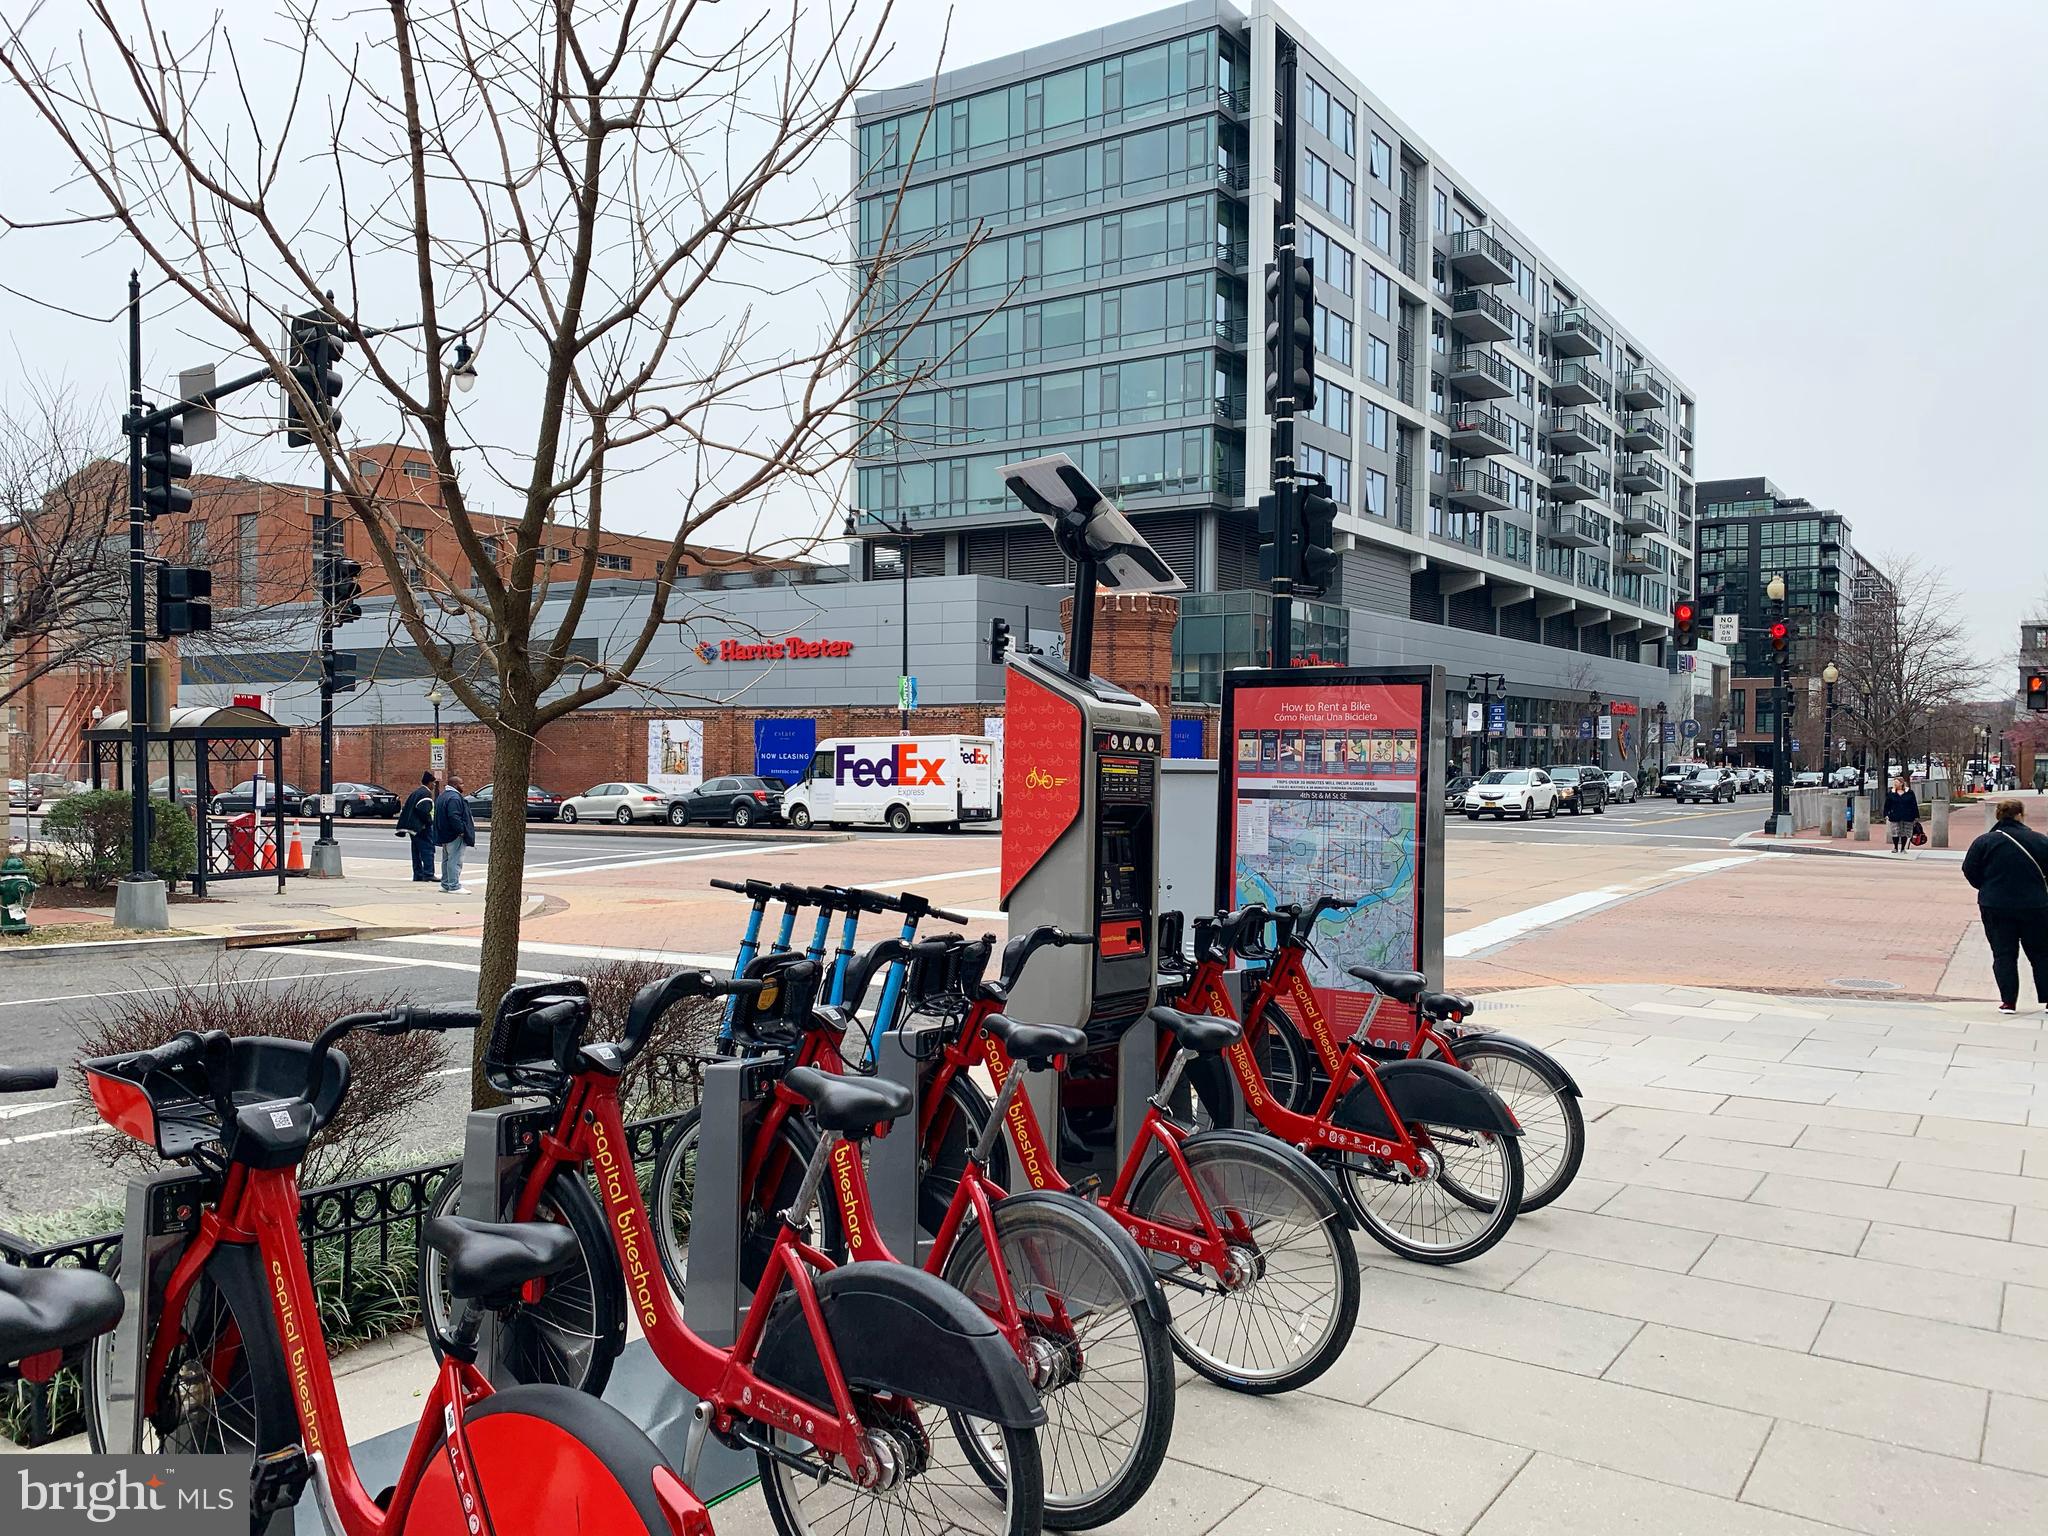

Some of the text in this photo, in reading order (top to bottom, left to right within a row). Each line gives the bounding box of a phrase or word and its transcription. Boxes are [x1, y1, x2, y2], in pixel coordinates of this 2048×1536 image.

[720, 637, 853, 661] Harris Teeter
[1273, 712, 1378, 722] Cómo Rentar Una Bicicleta
[1281, 702, 1303, 712] How
[1305, 703, 1315, 712] to
[1318, 702, 1340, 711] Rent
[1350, 701, 1371, 711] Bike
[835, 743, 946, 787] FedEx
[960, 747, 989, 765] edEx
[897, 787, 925, 797] Express
[1299, 791, 1310, 799] 4th
[1292, 976, 1320, 1019] capital
[1008, 1100, 1045, 1189] bikeshare
[834, 1143, 862, 1249] bikeshare
[592, 1121, 657, 1328] capital bikeshare
[272, 1260, 322, 1452] capital bikeshar
